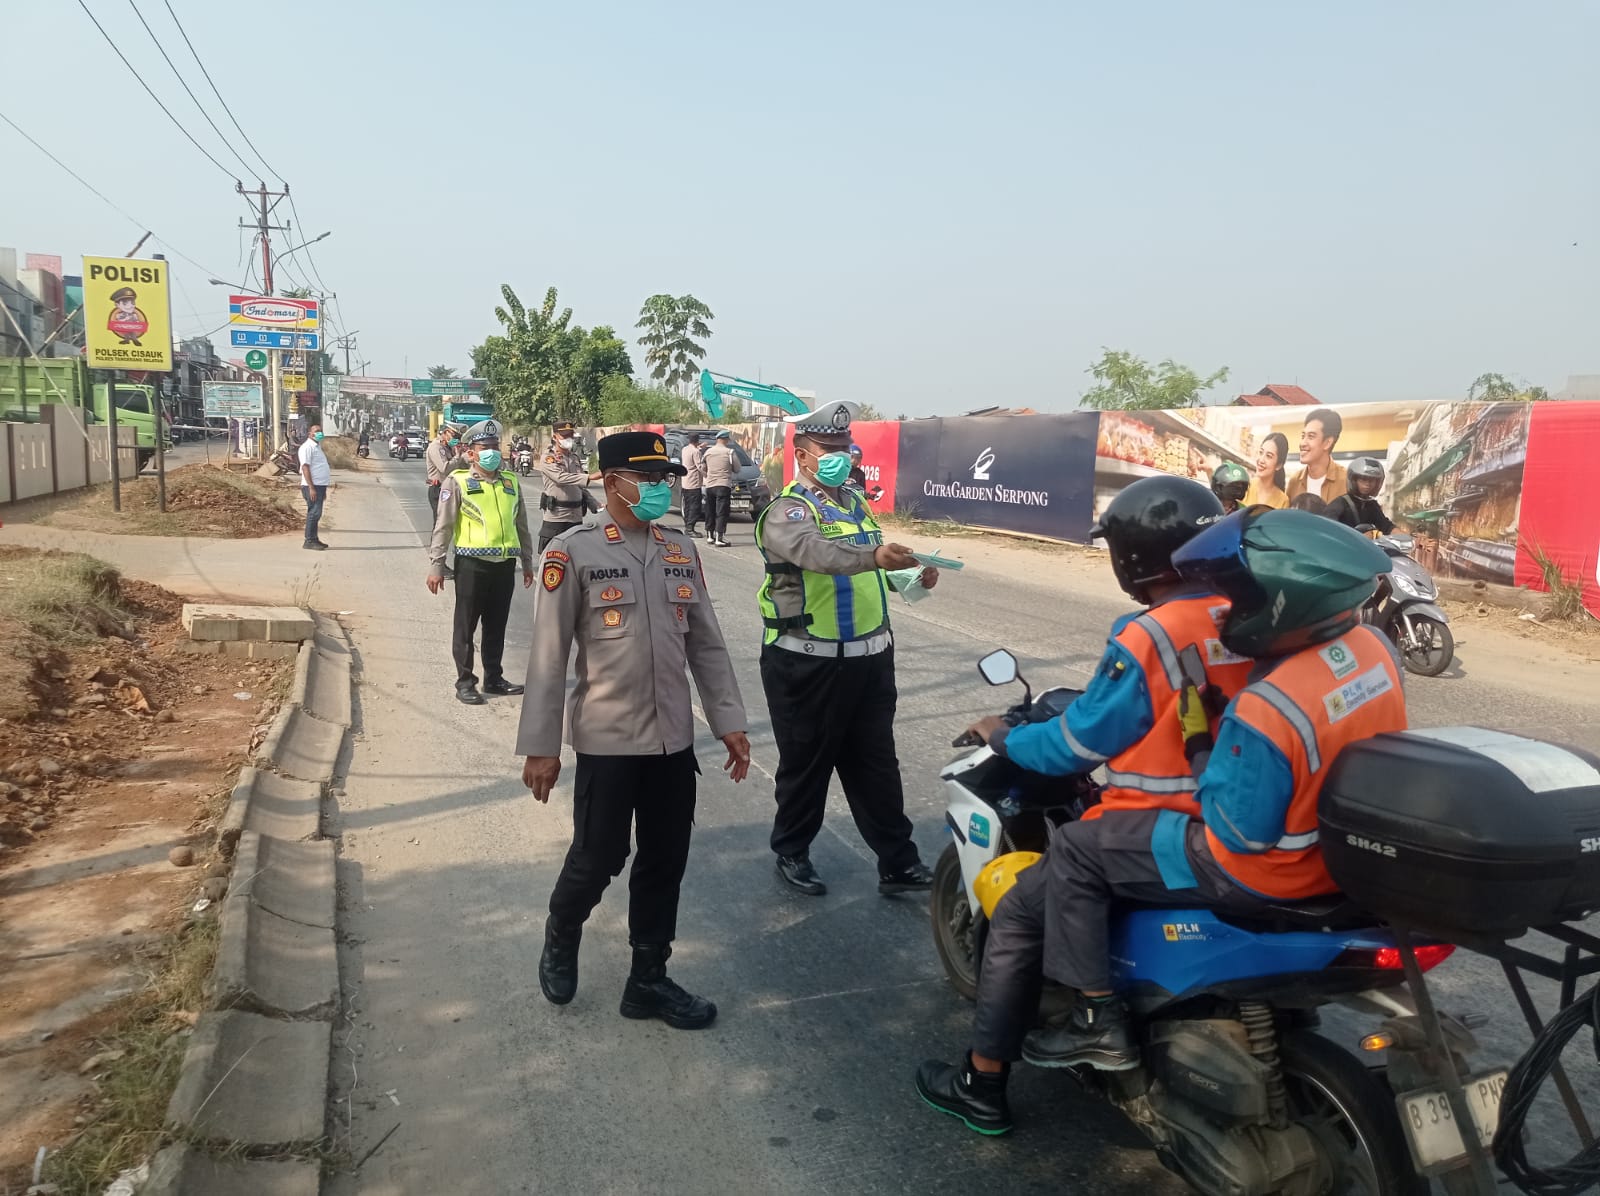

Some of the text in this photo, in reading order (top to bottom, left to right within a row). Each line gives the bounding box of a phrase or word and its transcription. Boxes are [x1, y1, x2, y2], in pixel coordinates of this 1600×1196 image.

[90, 264, 160, 284] POLISI
[246, 305, 303, 317] Indomare
[95, 348, 129, 357] POLSEK
[131, 350, 164, 359] CISAUK
[589, 567, 629, 581] AGUS.R
[664, 567, 695, 579] POLRI
[1346, 834, 1397, 858] SH42
[1176, 923, 1200, 933] PLN
[1410, 1104, 1422, 1129] B
